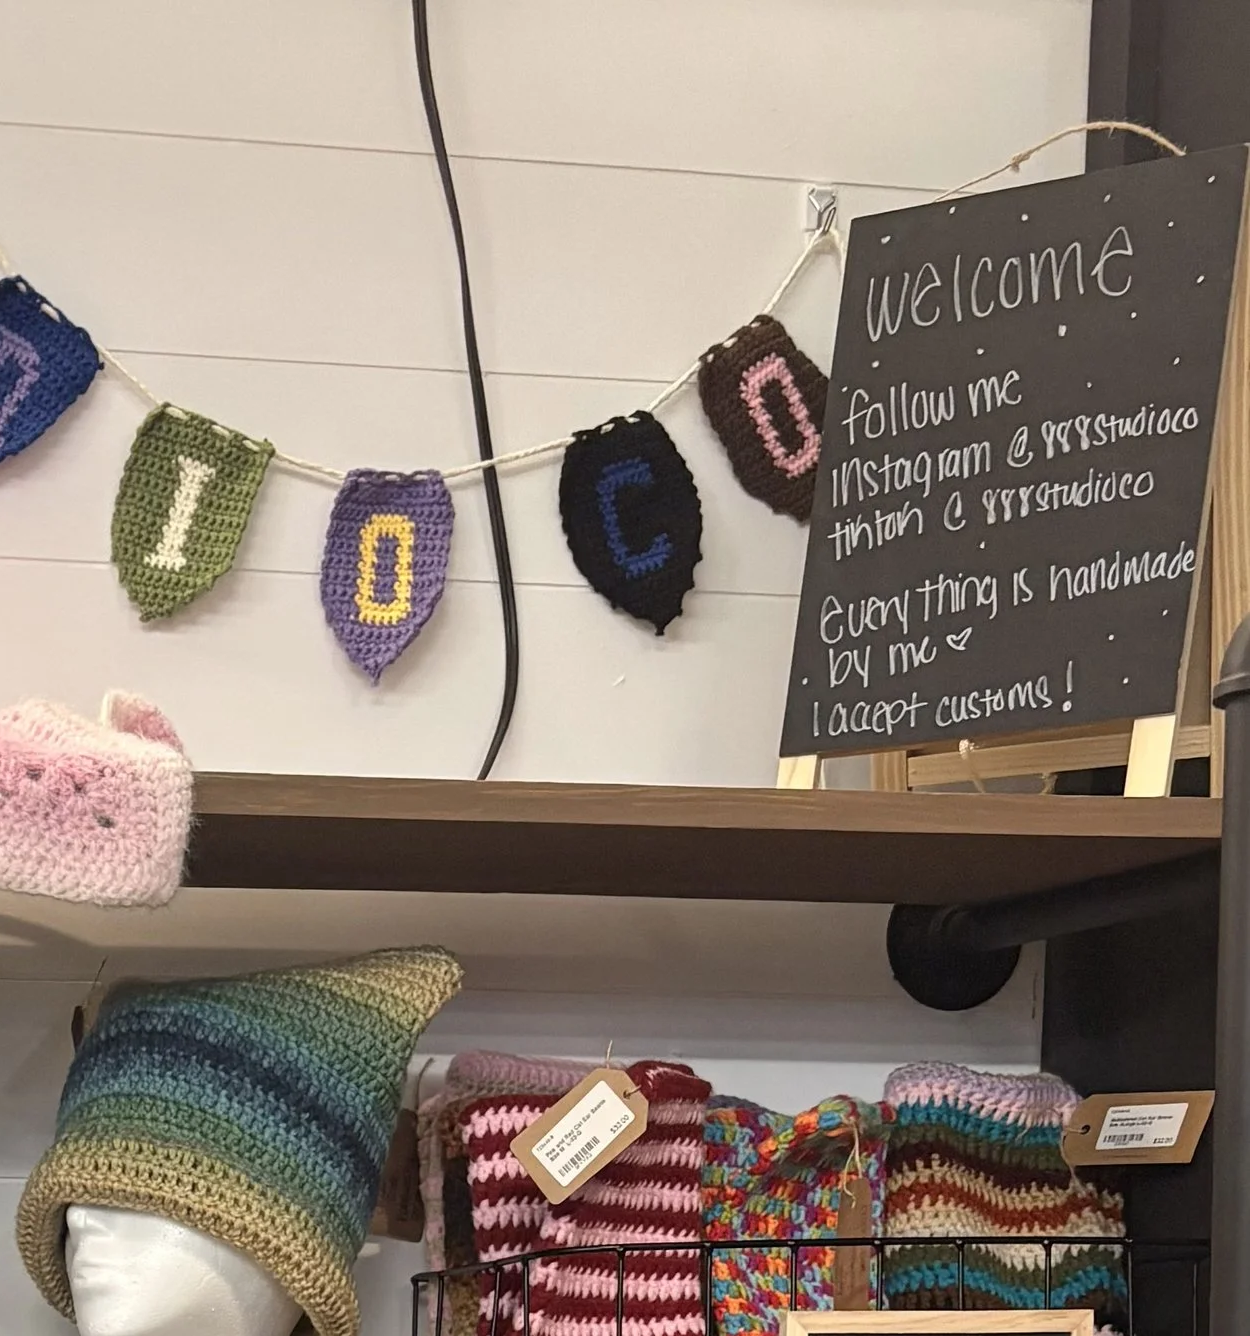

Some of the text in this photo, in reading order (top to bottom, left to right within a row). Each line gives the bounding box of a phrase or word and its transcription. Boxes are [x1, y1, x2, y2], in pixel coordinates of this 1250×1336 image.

[842, 369, 1022, 445] follow me
[1006, 425, 1033, 467] @
[1050, 541, 1196, 602] handmade
[828, 635, 937, 688] by me
